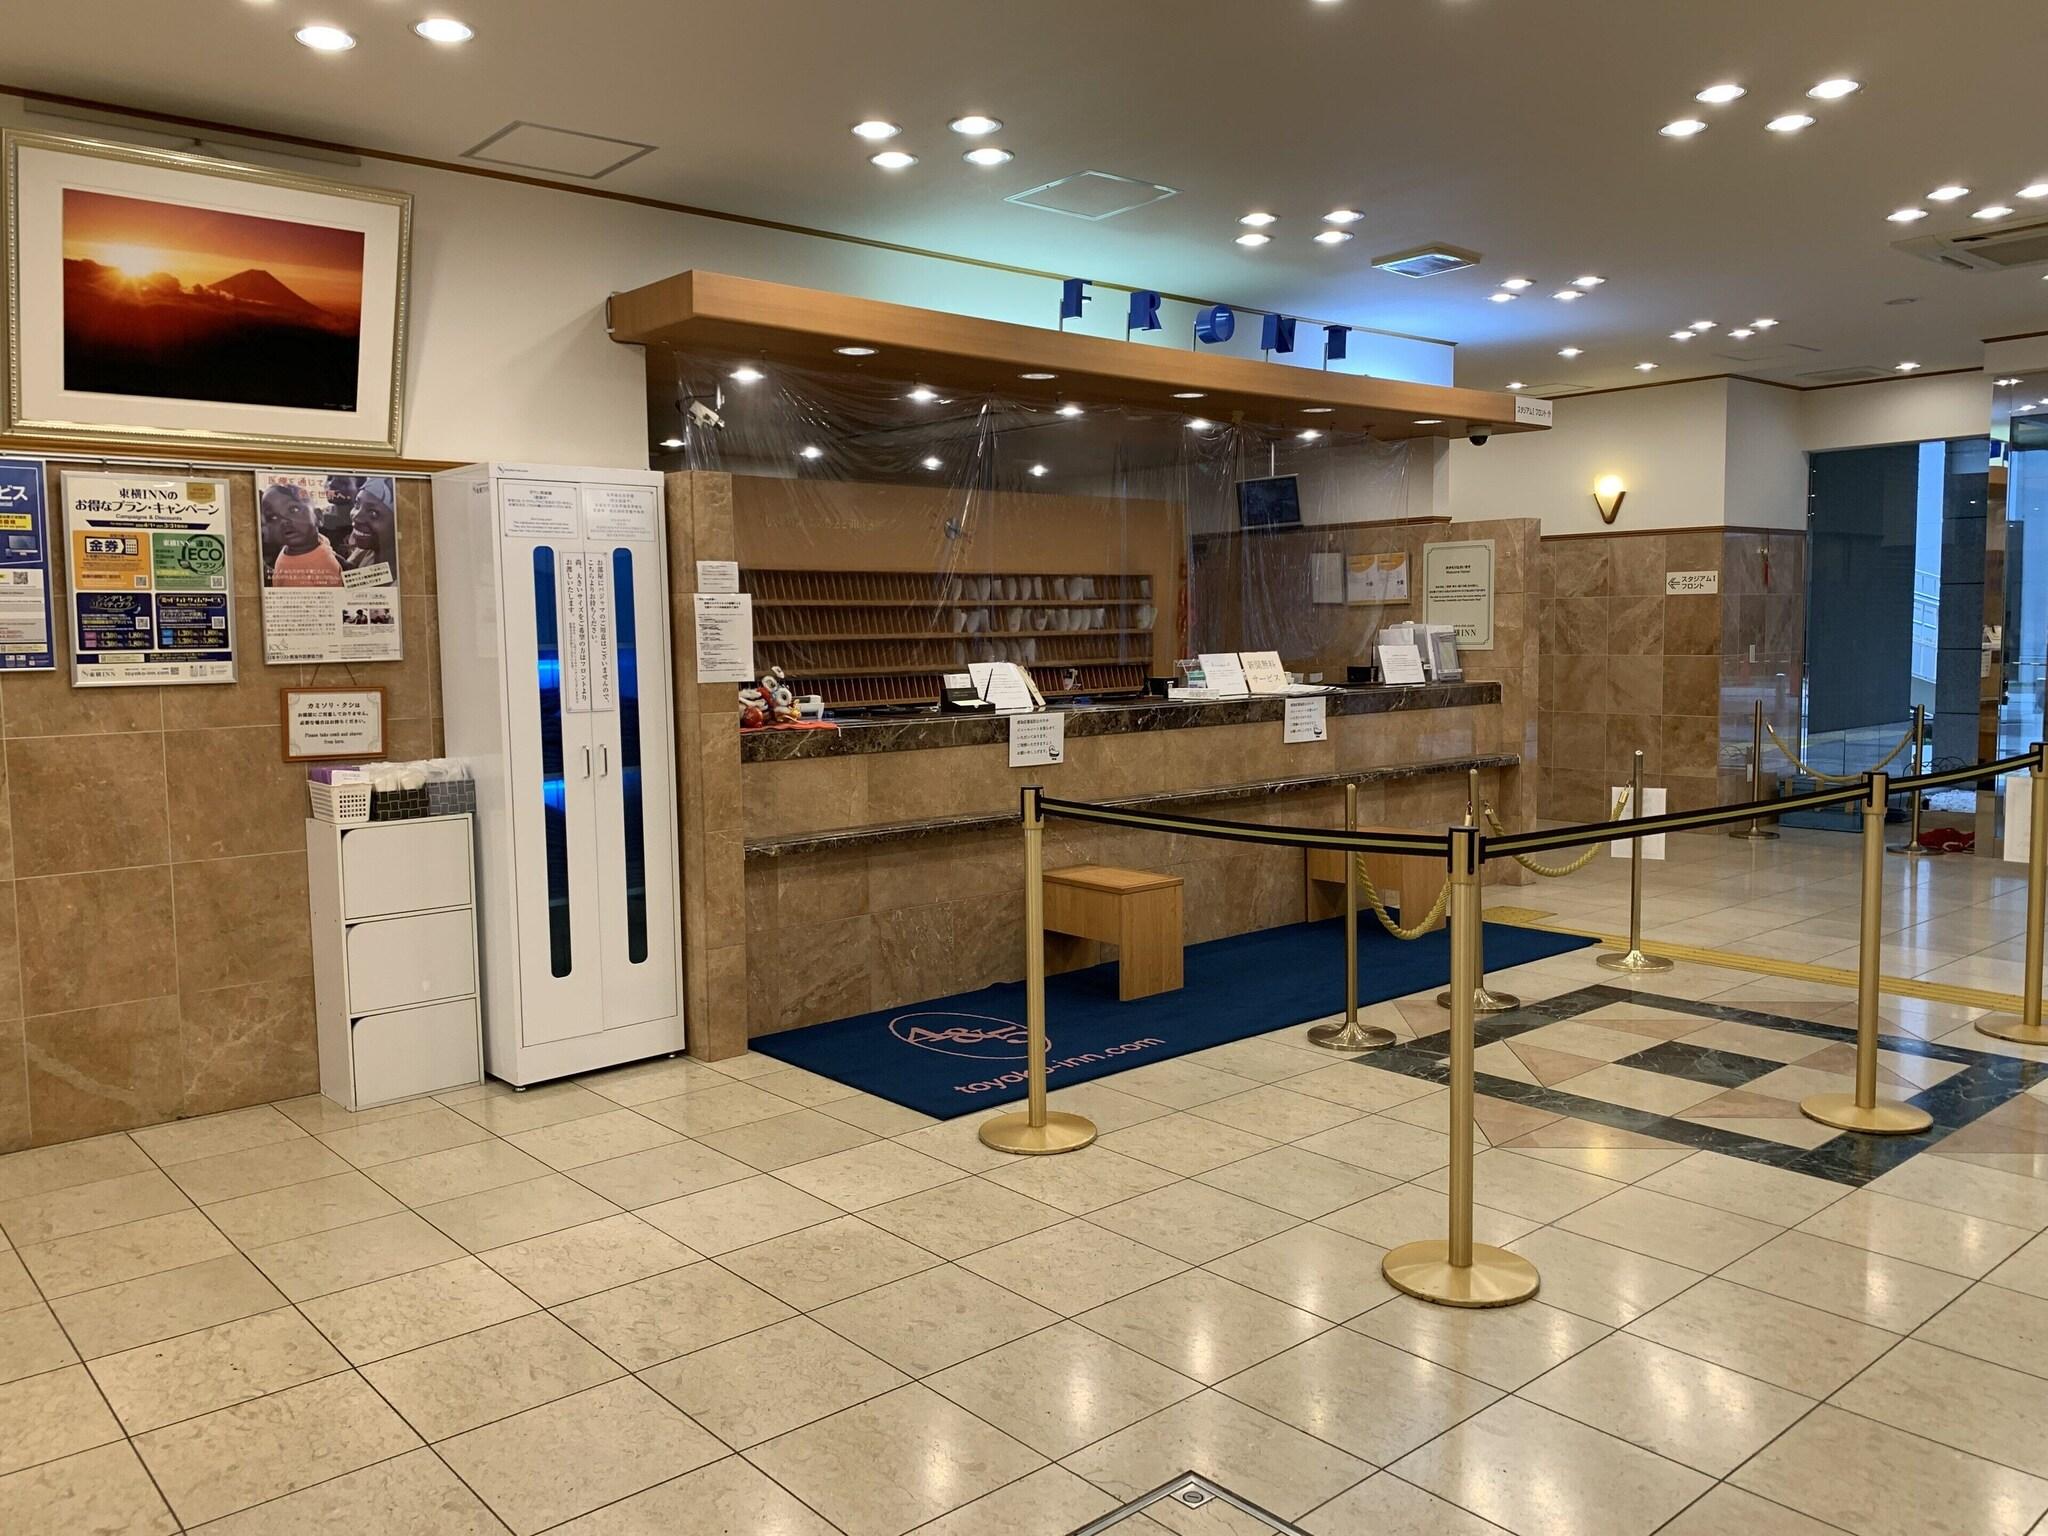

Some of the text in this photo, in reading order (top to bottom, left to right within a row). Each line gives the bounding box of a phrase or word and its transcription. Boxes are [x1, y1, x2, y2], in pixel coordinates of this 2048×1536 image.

[1062, 278, 1352, 360] FRONT
[119, 487, 178, 501] 東横INNの
[75, 499, 220, 515] お得なプラン・キャンペーン
[89, 539, 119, 553] 金券
[188, 548, 222, 561] ECO
[1247, 659, 1276, 670] 新聞無料
[1253, 674, 1281, 683] サービス
